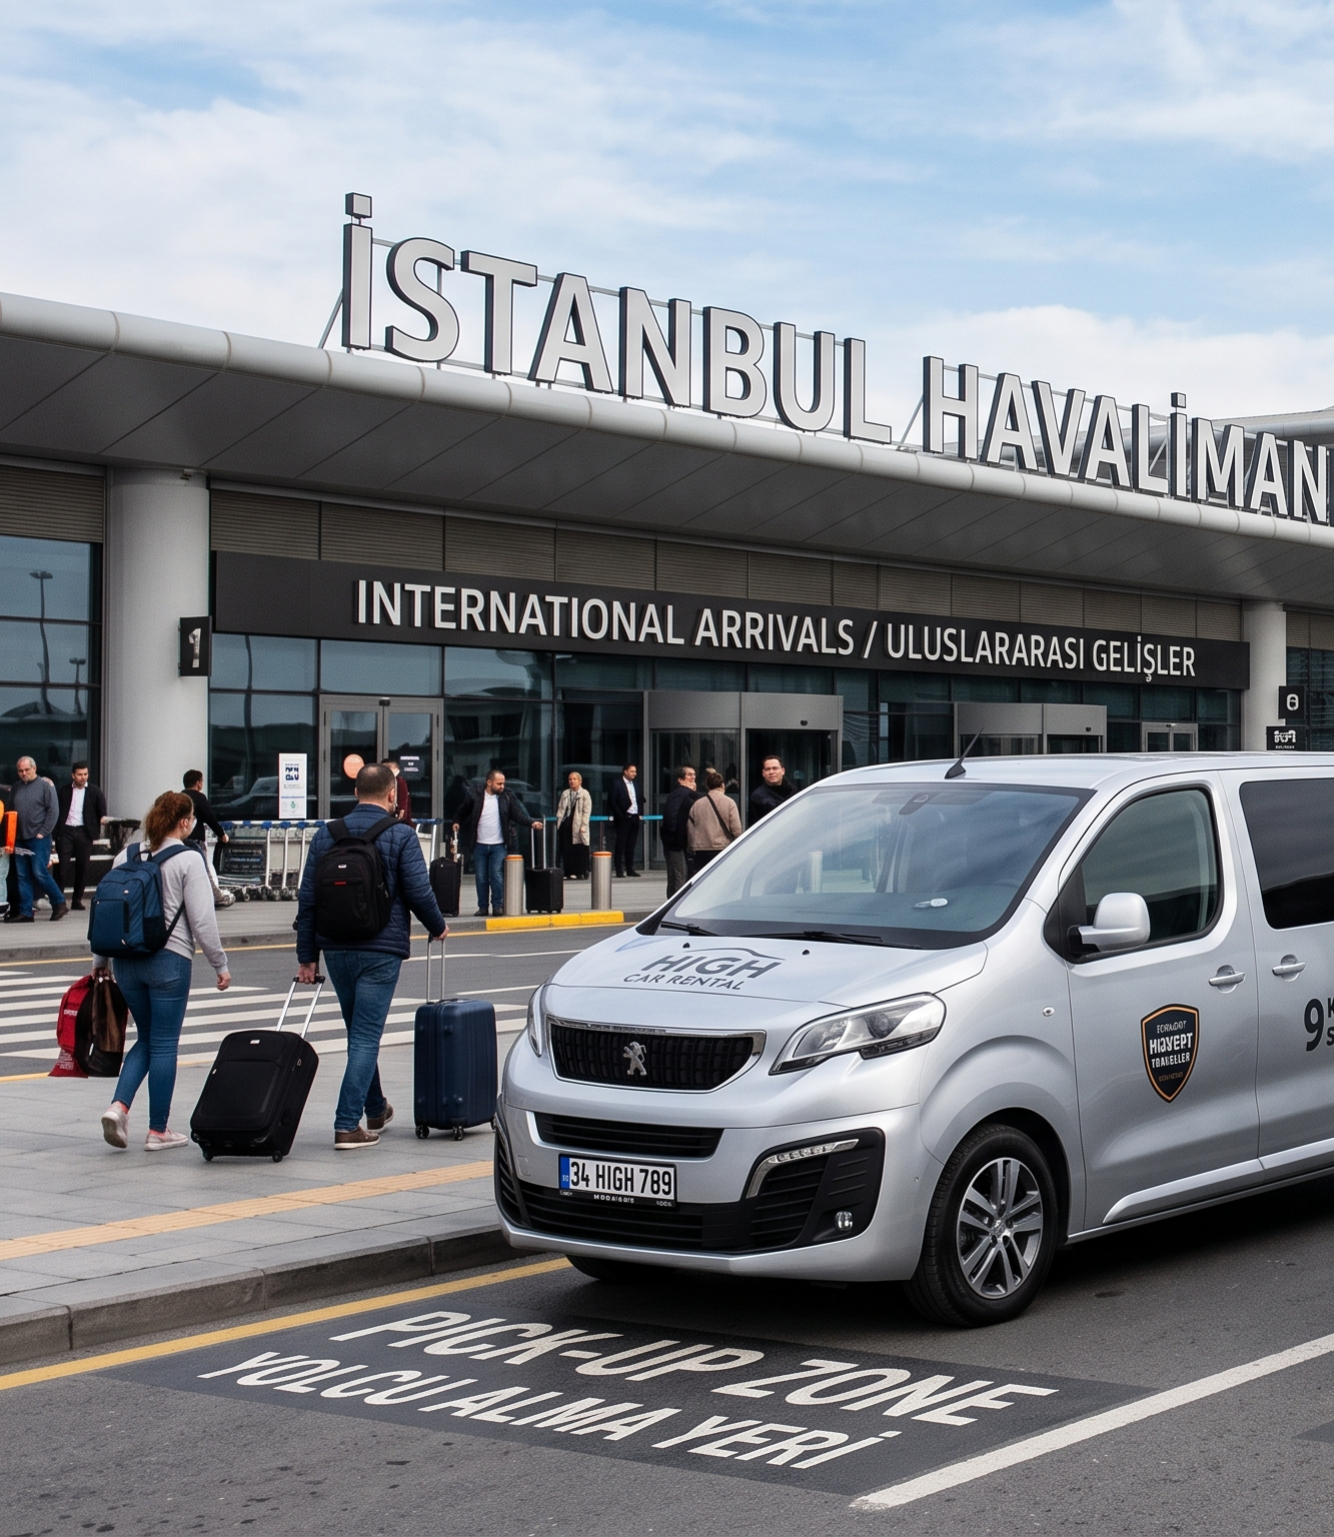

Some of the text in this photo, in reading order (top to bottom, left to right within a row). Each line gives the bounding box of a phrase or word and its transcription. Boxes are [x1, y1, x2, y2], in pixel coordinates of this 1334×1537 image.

[342, 192, 892, 444] İSTANBUL
[356, 580, 1196, 682] INTERNATIONAL ARRIVALS / ULUSLARARASI GELİŞLER
[623, 973, 744, 991] CAR RENTAL
[641, 955, 782, 979] HIGH
[1304, 998, 1325, 1052] 9
[570, 1161, 672, 1196] 34 HIGH 789
[329, 1311, 1059, 1426] PICK-UP ZONE
[197, 1351, 902, 1469] YOLCU ALMA YERİ
